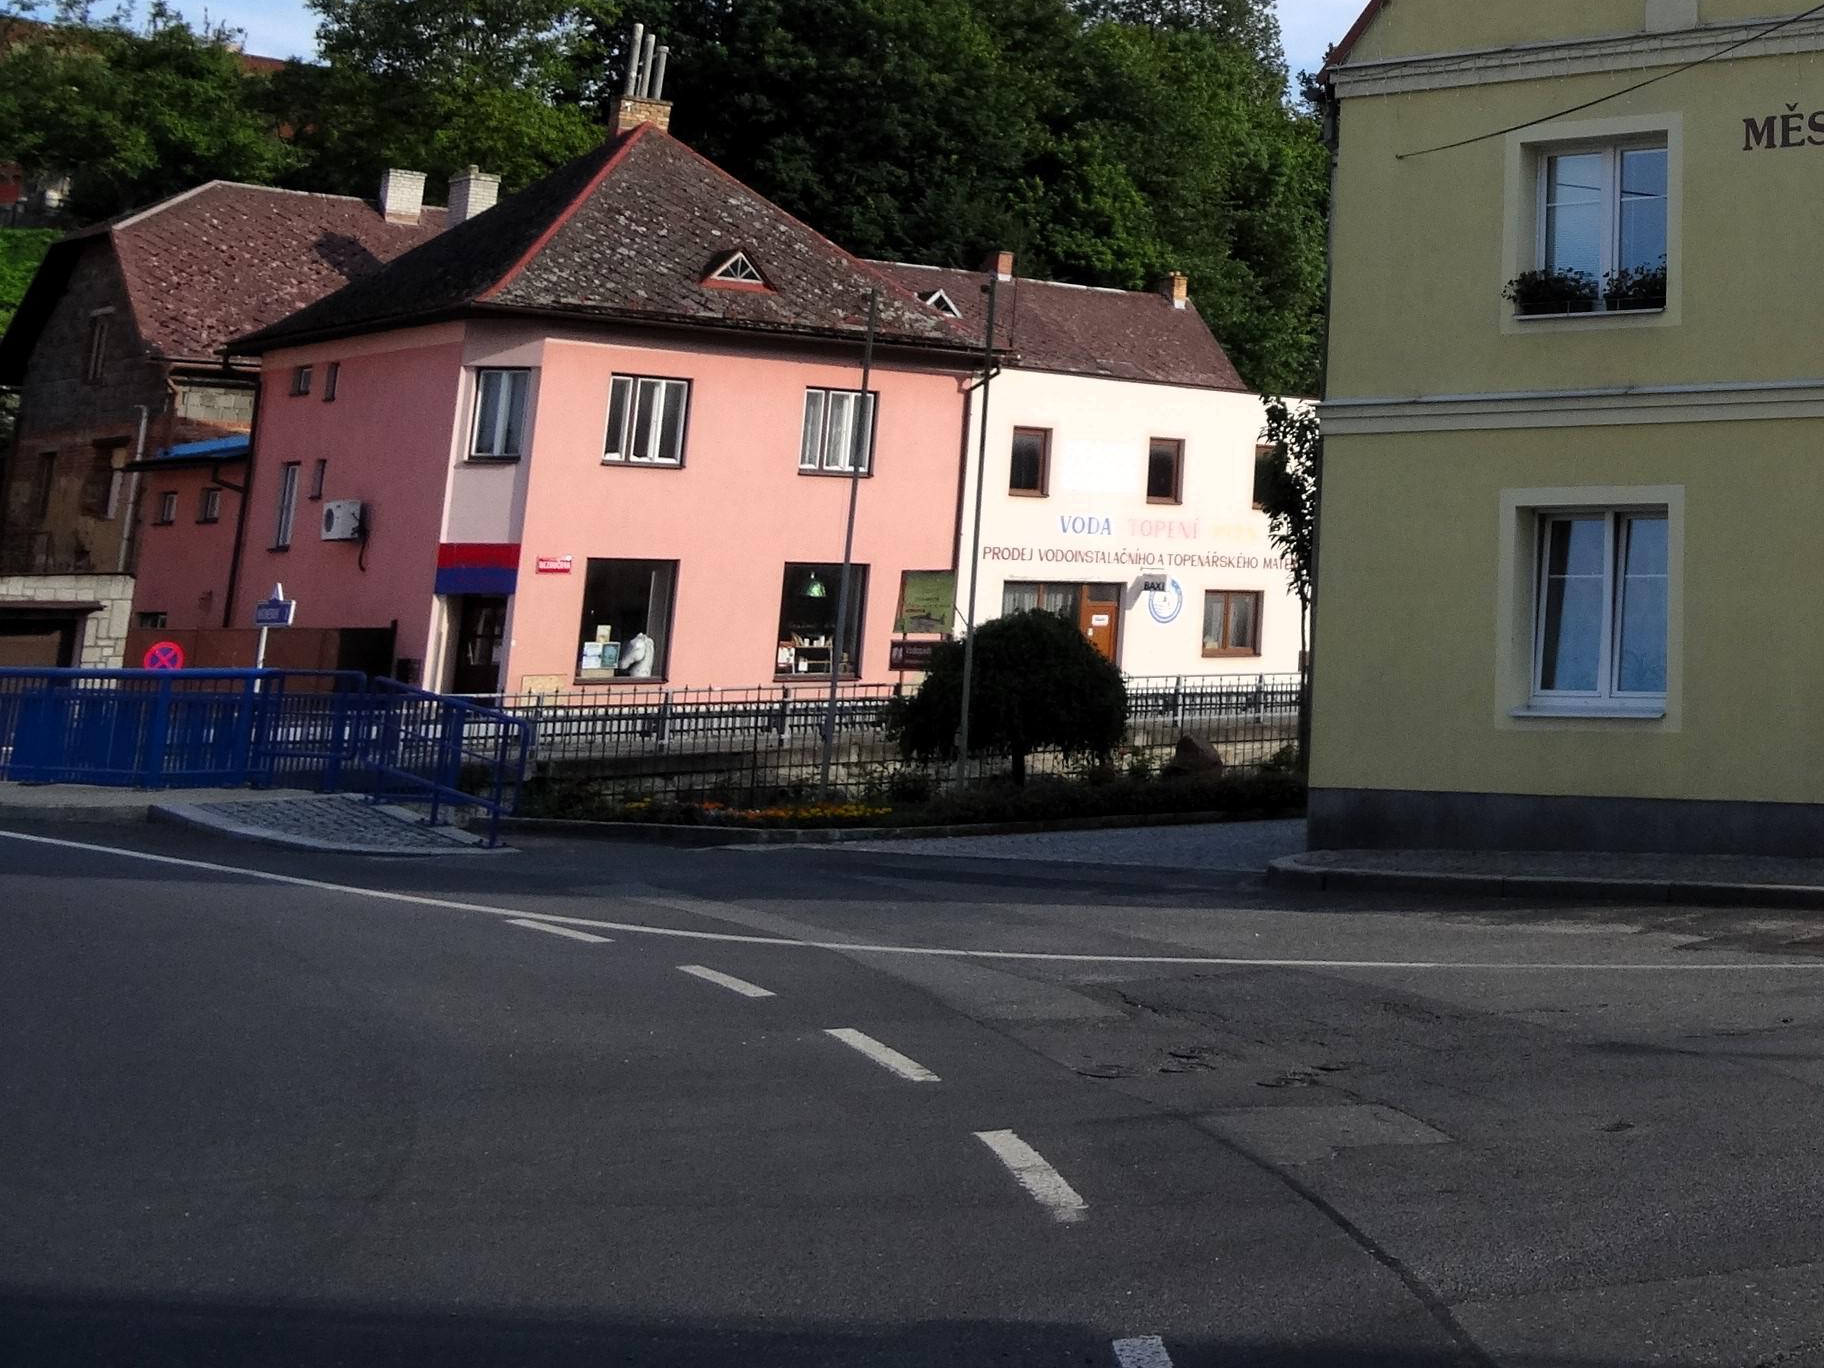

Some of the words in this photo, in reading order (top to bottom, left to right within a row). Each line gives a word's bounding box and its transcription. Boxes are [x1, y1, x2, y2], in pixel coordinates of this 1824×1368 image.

[1060, 515, 1112, 536] VODA
[1128, 517, 1200, 540] TOPENÍ
[982, 546, 1034, 562] PRODEJ
[1038, 547, 1156, 566] VODOINSTALAČNÍHO
[1157, 552, 1165, 566] A
[1167, 550, 1259, 570] TOPENÁŘSKÉHO
[1143, 581, 1166, 592] BAXI
